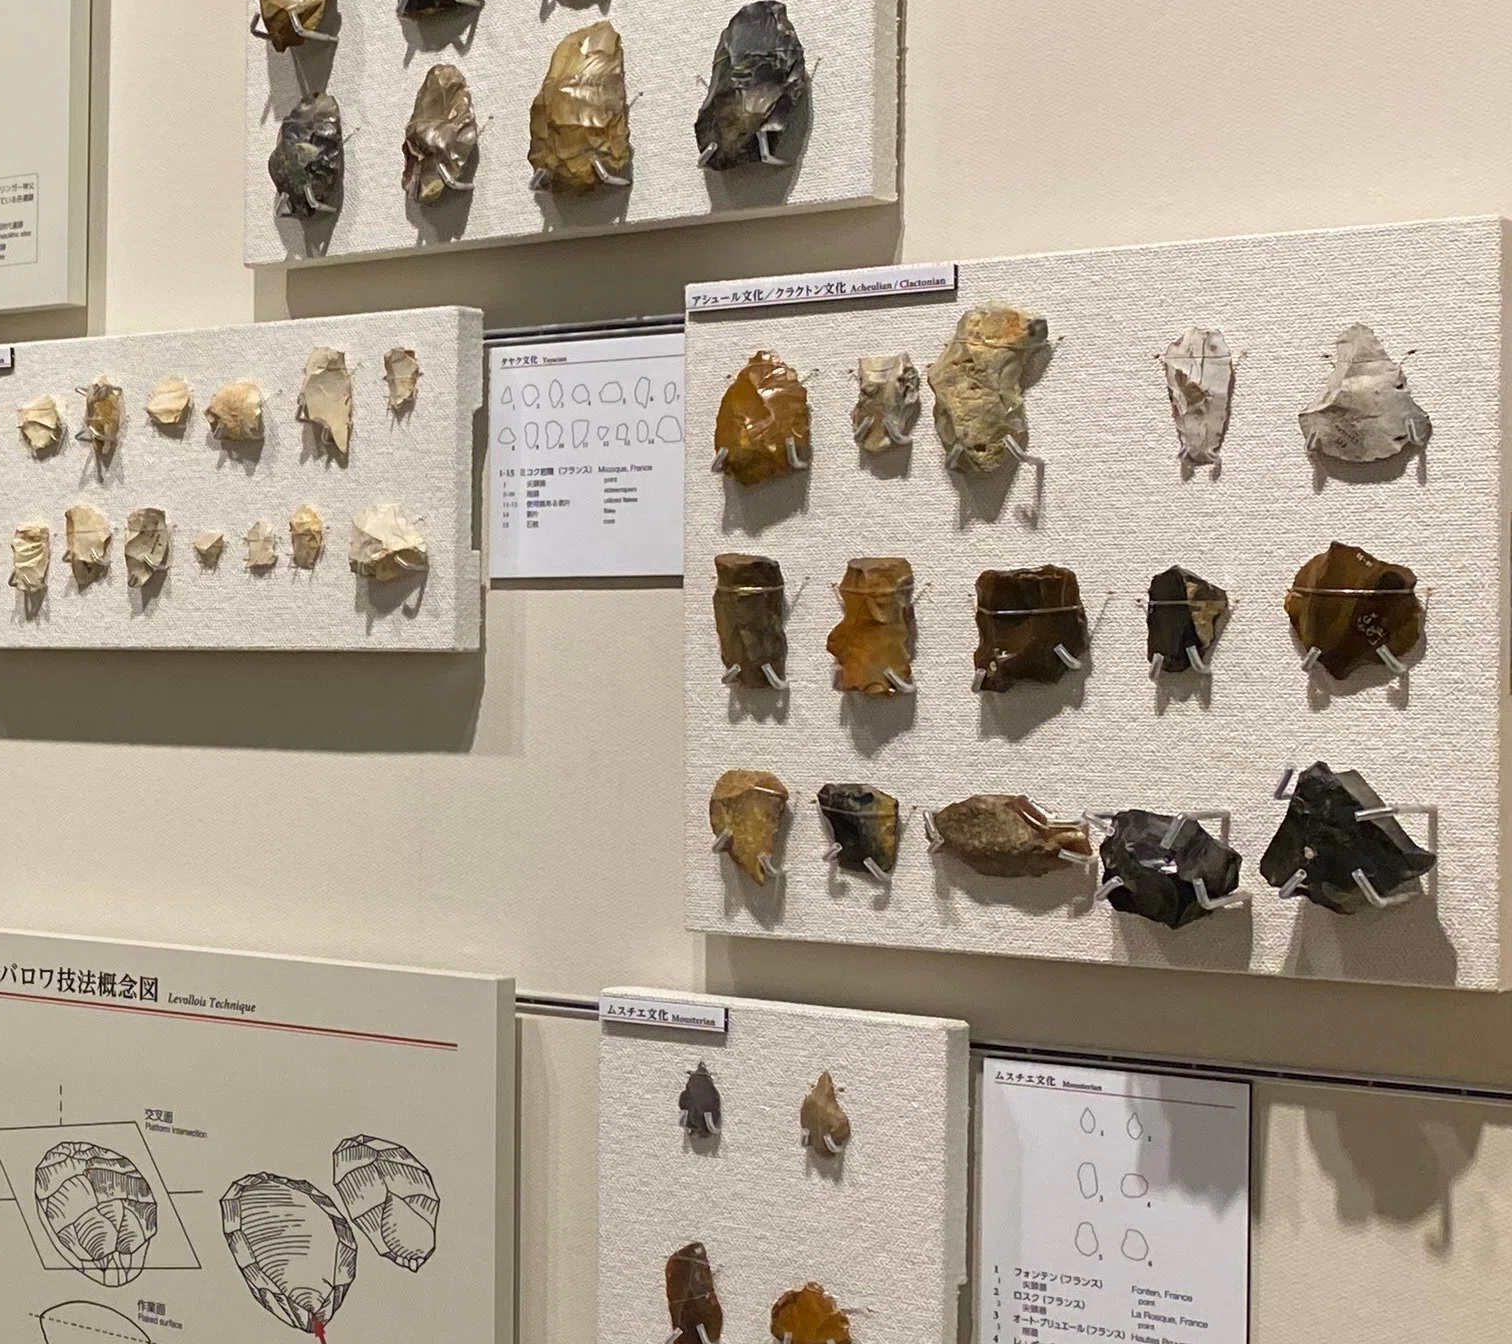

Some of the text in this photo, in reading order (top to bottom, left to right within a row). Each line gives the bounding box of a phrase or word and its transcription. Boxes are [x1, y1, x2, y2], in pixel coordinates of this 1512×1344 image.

[850, 282, 892, 293] Acheulian
[900, 277, 946, 289] Clactonian
[502, 356, 538, 366] タヤク文化
[209, 998, 256, 1013] Technique
[607, 1005, 668, 1021] ムスチエ文化
[996, 1071, 1056, 1086] ムスチエ文化
[1165, 1290, 1193, 1302] France
[1131, 1309, 1142, 1318] La
[1180, 1316, 1208, 1328] France
